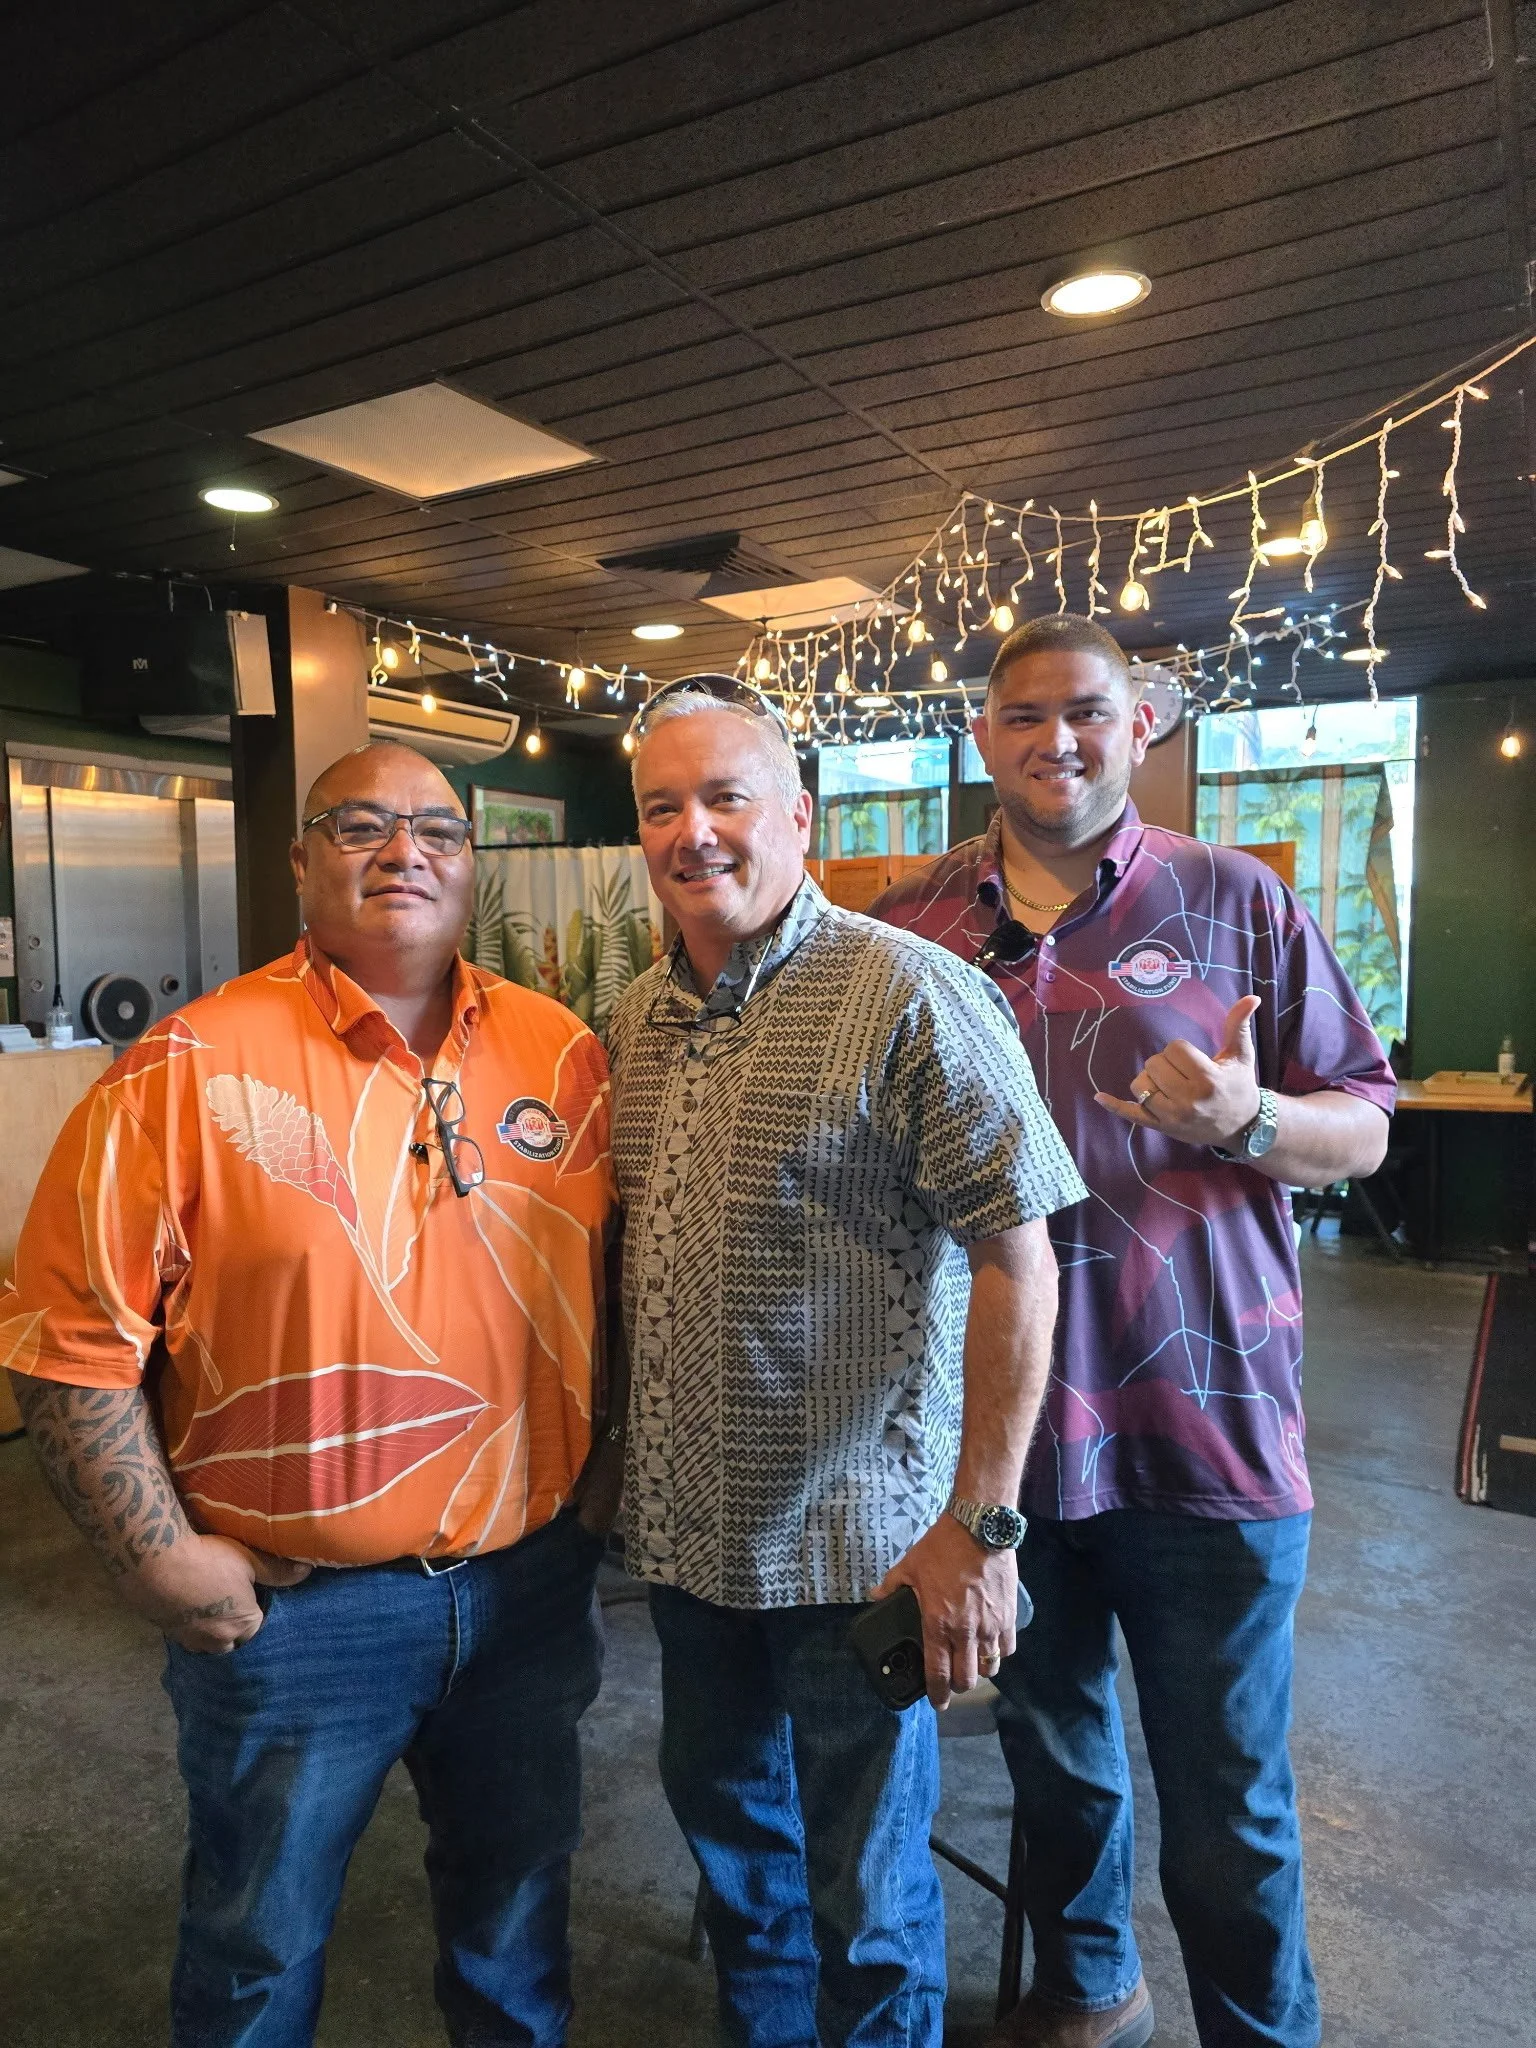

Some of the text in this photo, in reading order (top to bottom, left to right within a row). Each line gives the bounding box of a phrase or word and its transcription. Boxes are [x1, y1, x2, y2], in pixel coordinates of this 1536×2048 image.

[1120, 976, 1178, 994] STABILIZATION FUND
[513, 1138, 562, 1158] STABILIZATION FUND
